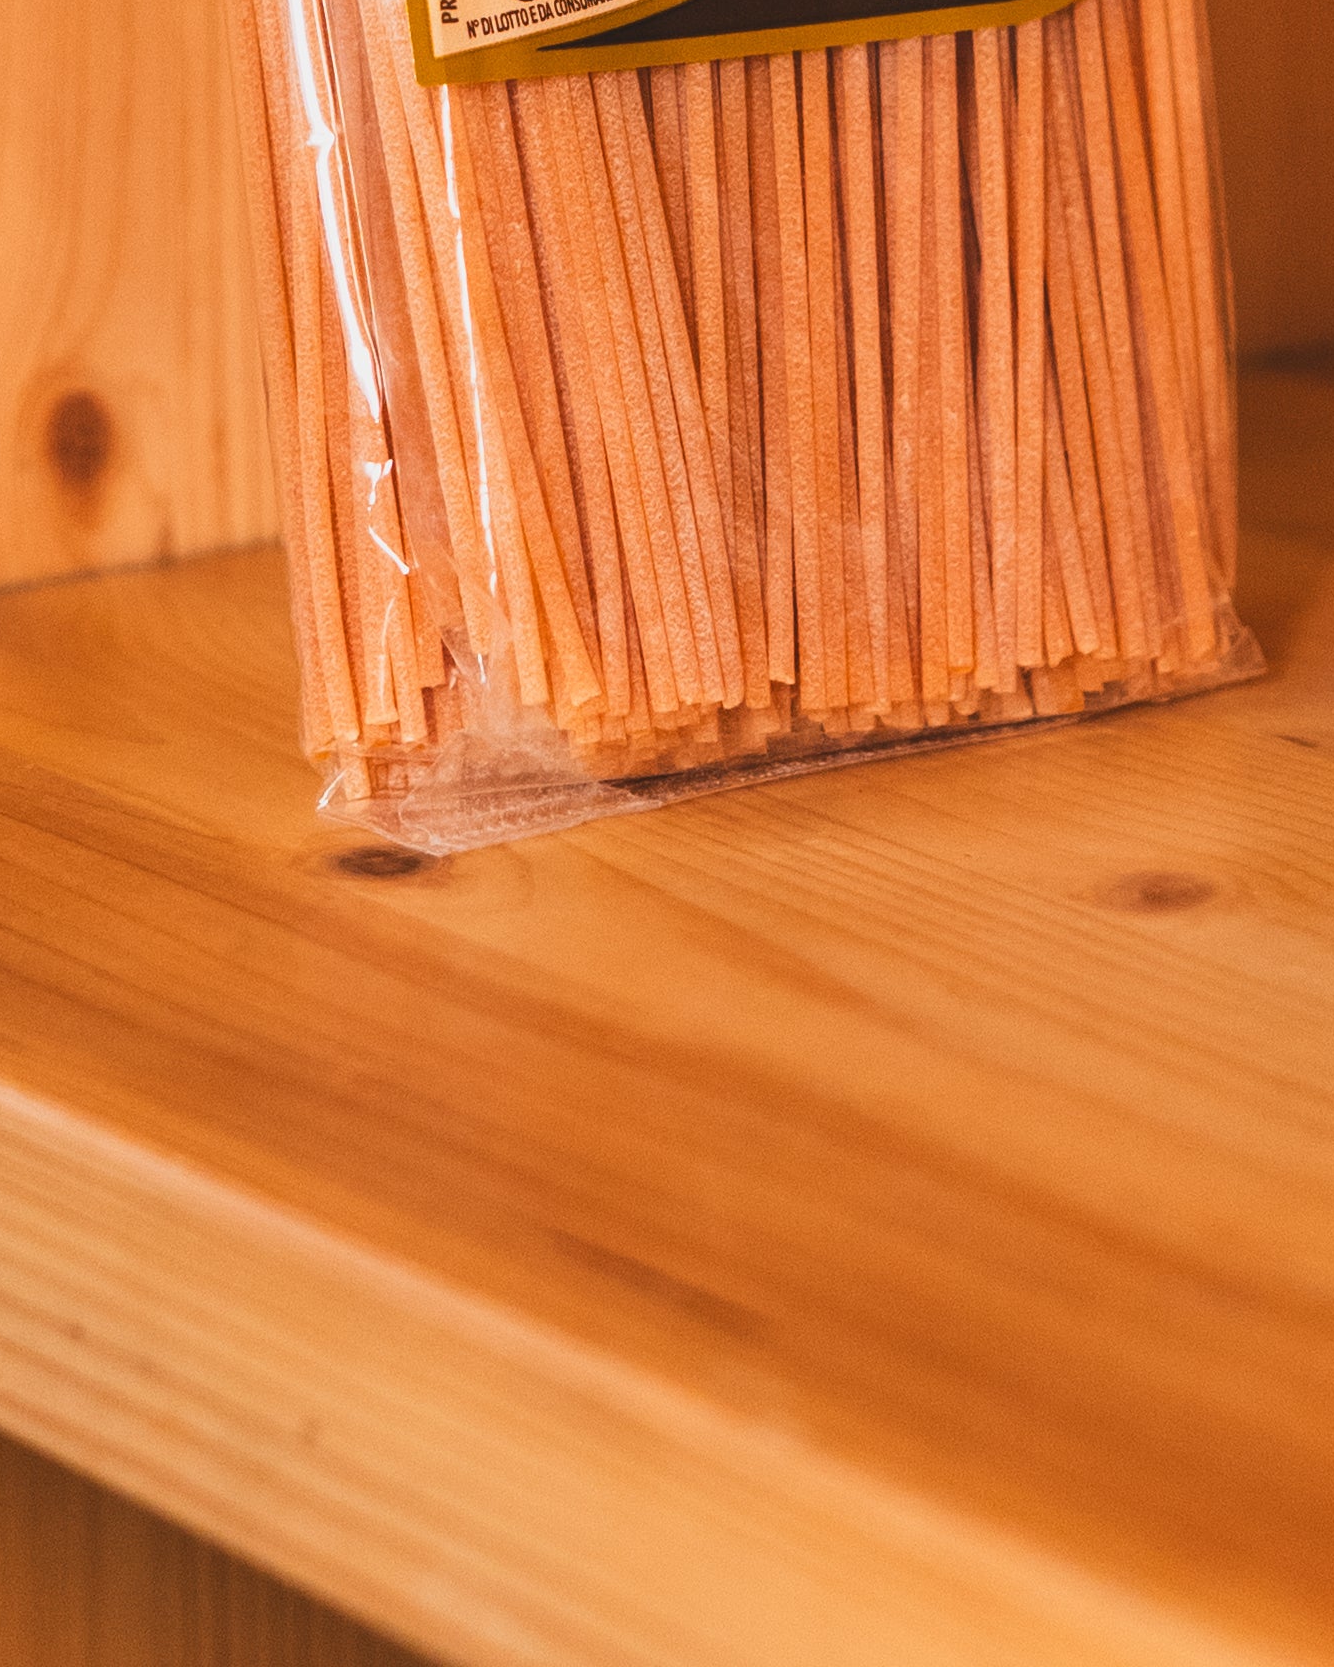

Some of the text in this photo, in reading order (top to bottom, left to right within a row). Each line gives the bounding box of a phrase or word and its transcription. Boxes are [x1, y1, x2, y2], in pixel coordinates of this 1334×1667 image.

[481, 16, 494, 36] DI
[494, 8, 529, 33] LOTTO
[537, 2, 554, 22] DA
